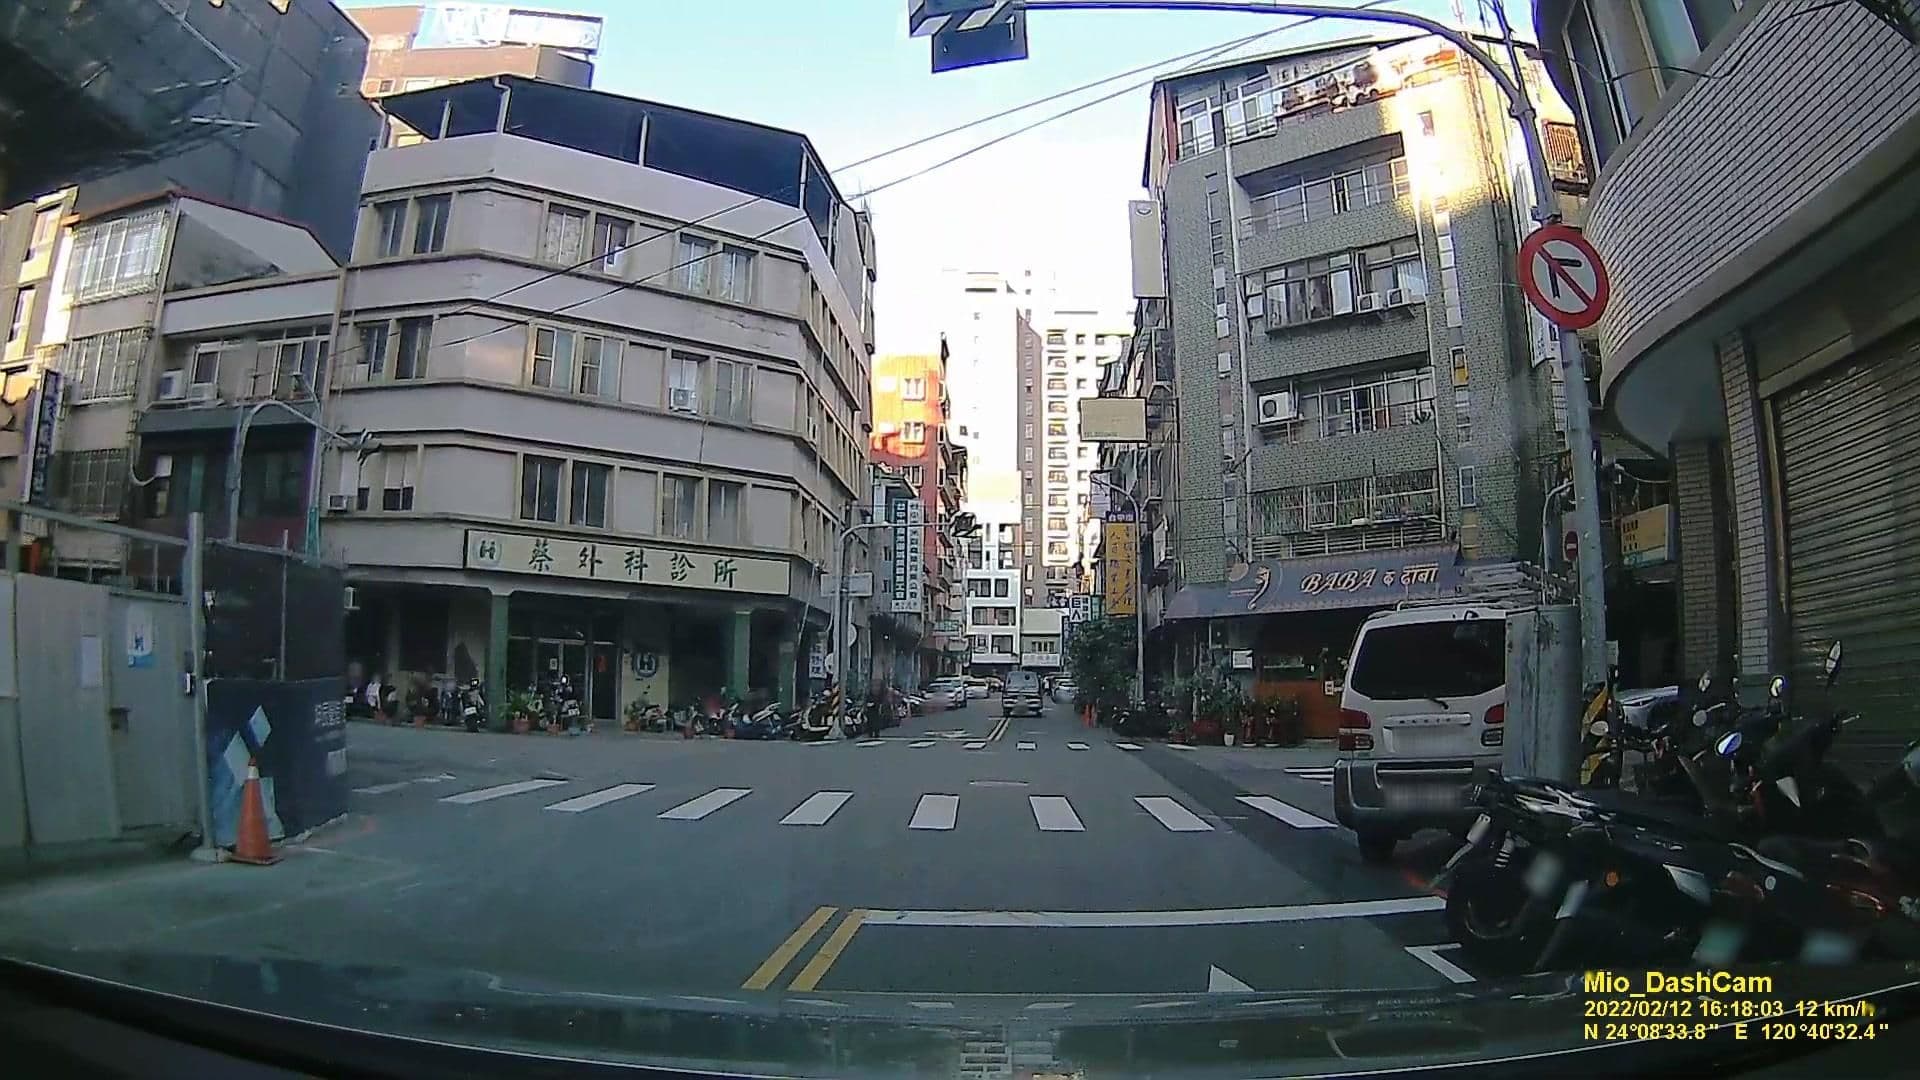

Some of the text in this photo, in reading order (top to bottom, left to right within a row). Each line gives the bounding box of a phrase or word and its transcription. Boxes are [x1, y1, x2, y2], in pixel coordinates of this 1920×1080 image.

[528, 538, 738, 588] 蔡外科診所
[1301, 568, 1377, 595] BABA
